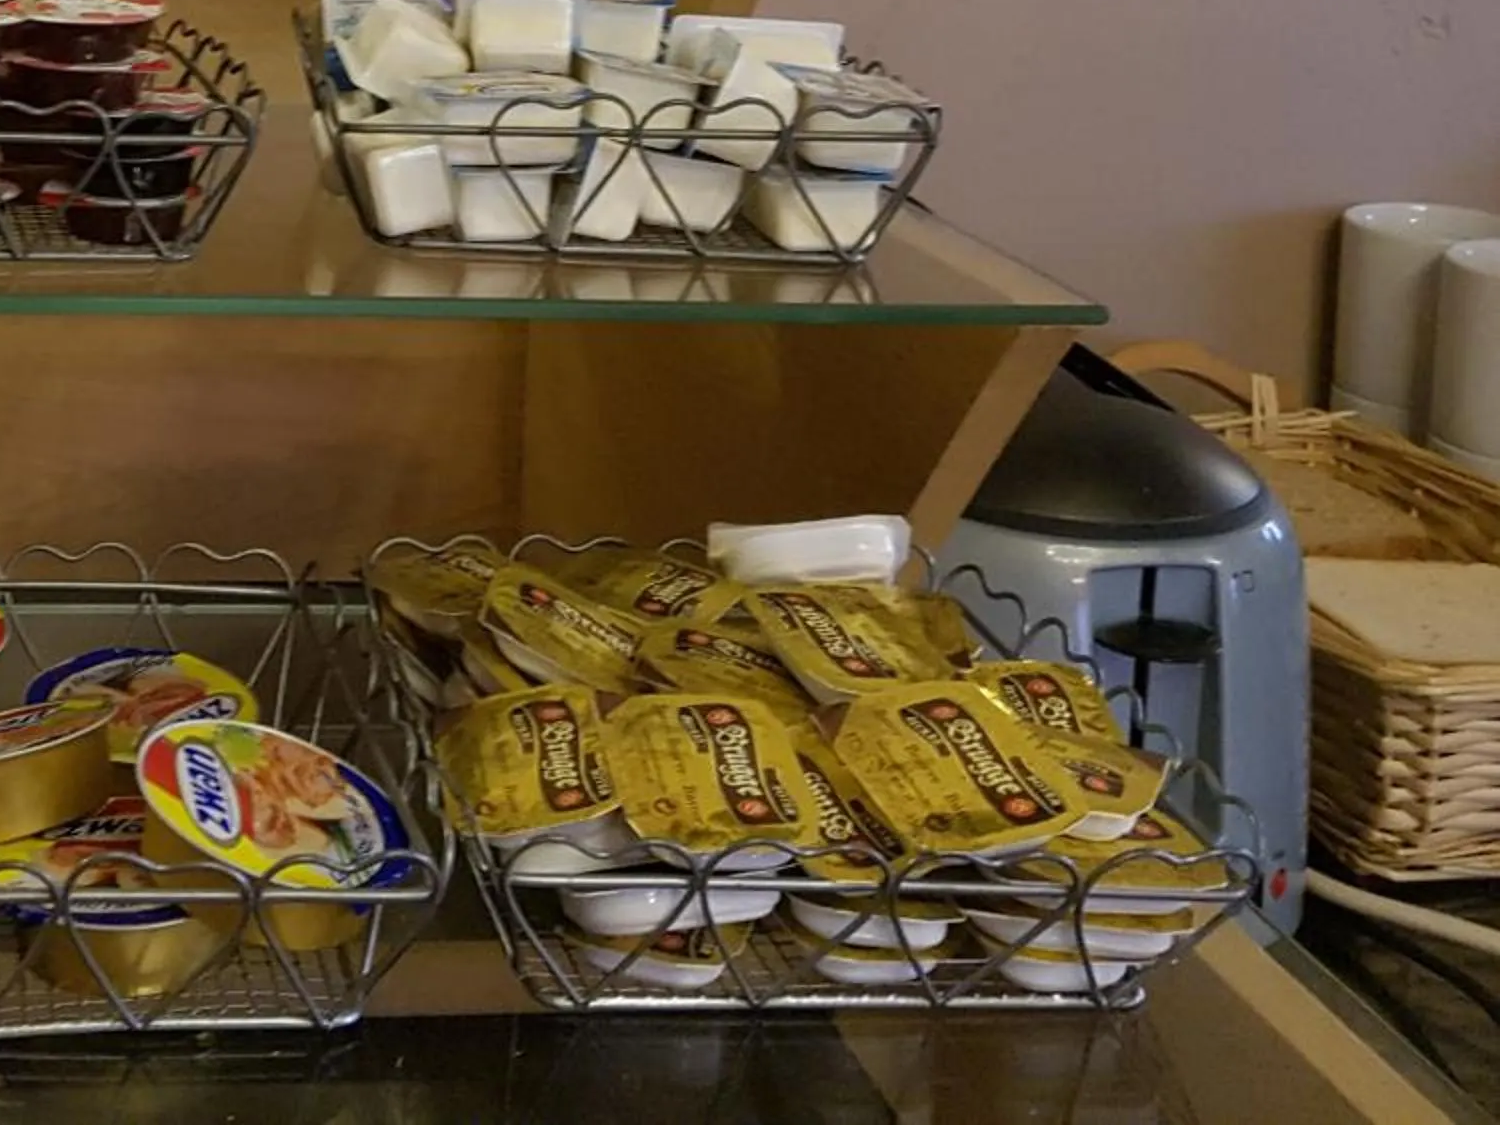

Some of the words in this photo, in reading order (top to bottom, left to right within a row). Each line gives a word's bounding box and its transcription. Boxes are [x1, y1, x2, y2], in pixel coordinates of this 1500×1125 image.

[540, 720, 581, 789] Brugge
[713, 724, 765, 798] Brugge
[946, 716, 1023, 797] Brugge
